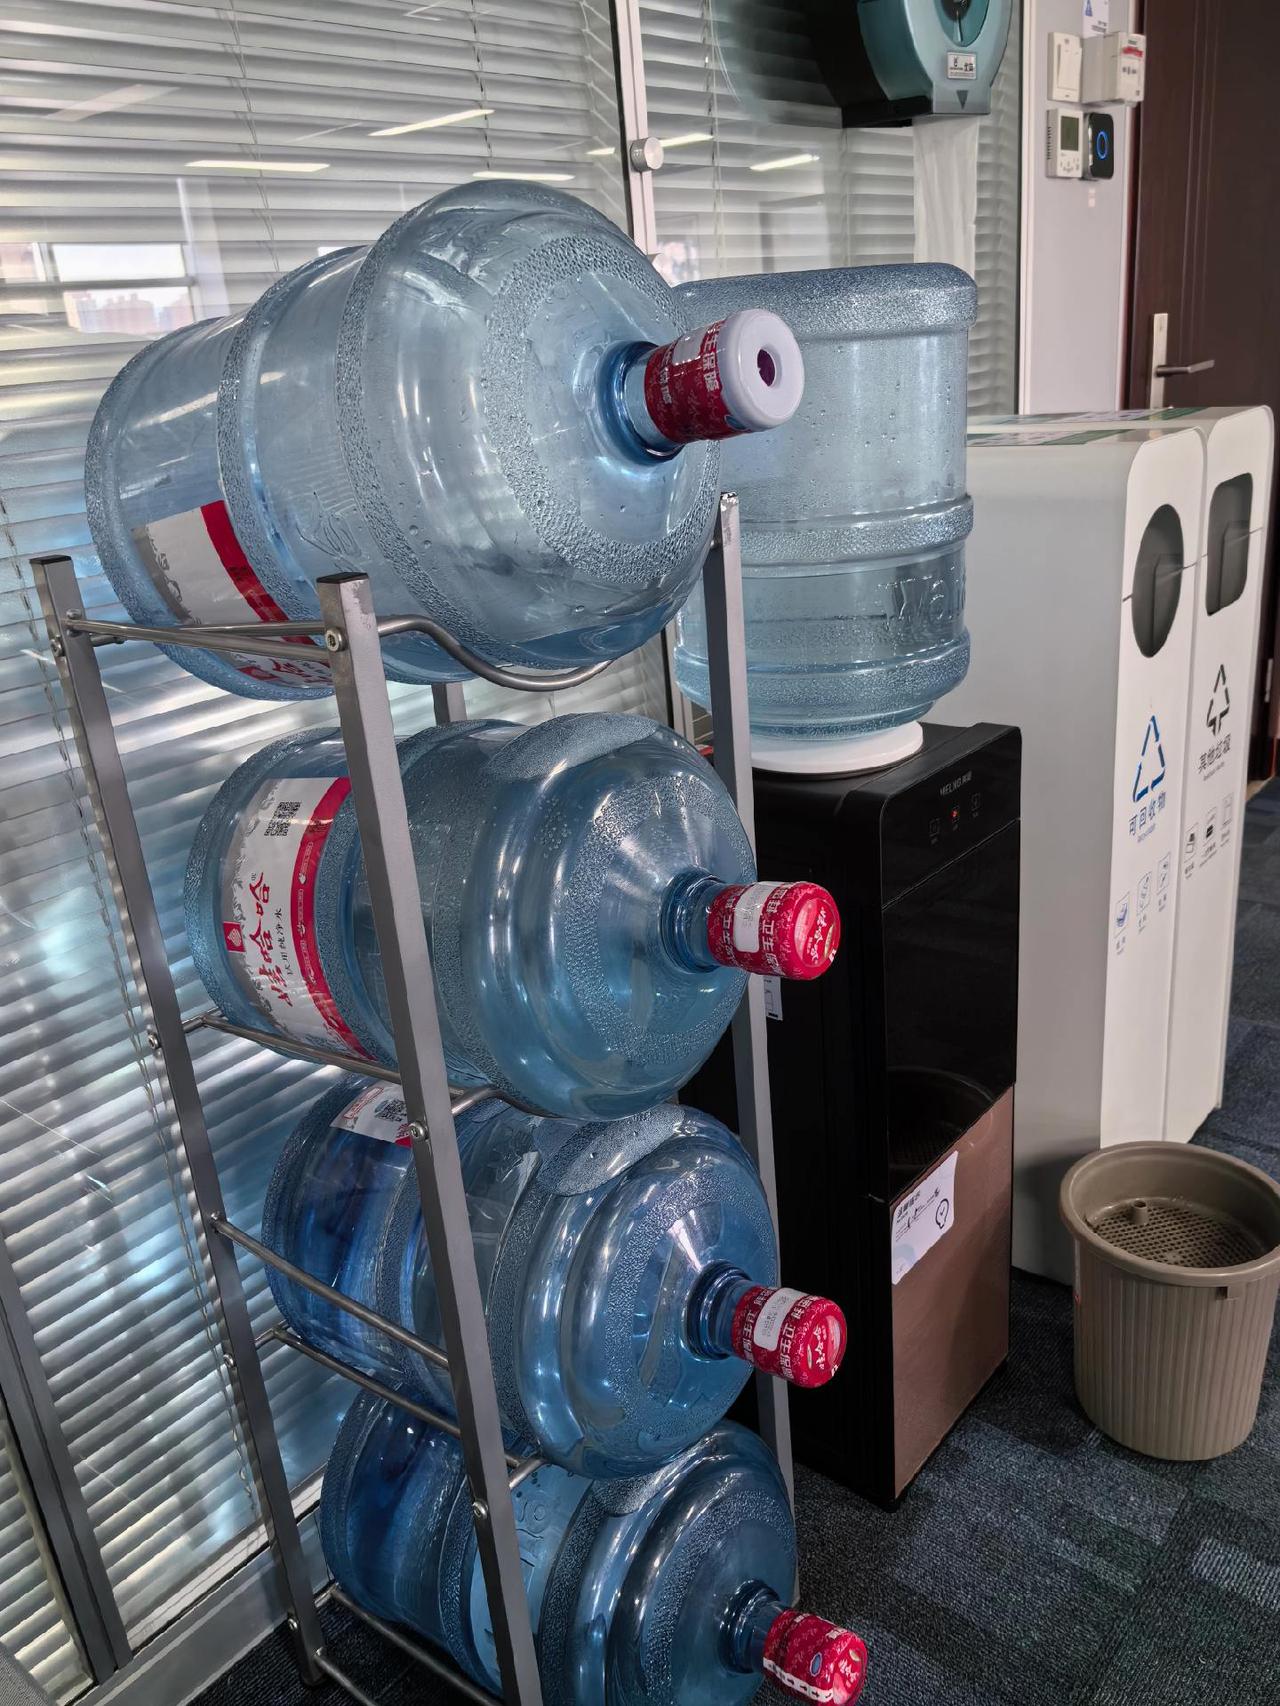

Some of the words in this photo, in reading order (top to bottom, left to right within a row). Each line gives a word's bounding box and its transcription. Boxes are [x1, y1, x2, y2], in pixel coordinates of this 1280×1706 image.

[1128, 791, 1166, 836] 可回收物
[249, 871, 293, 1007] 娃哈哈
